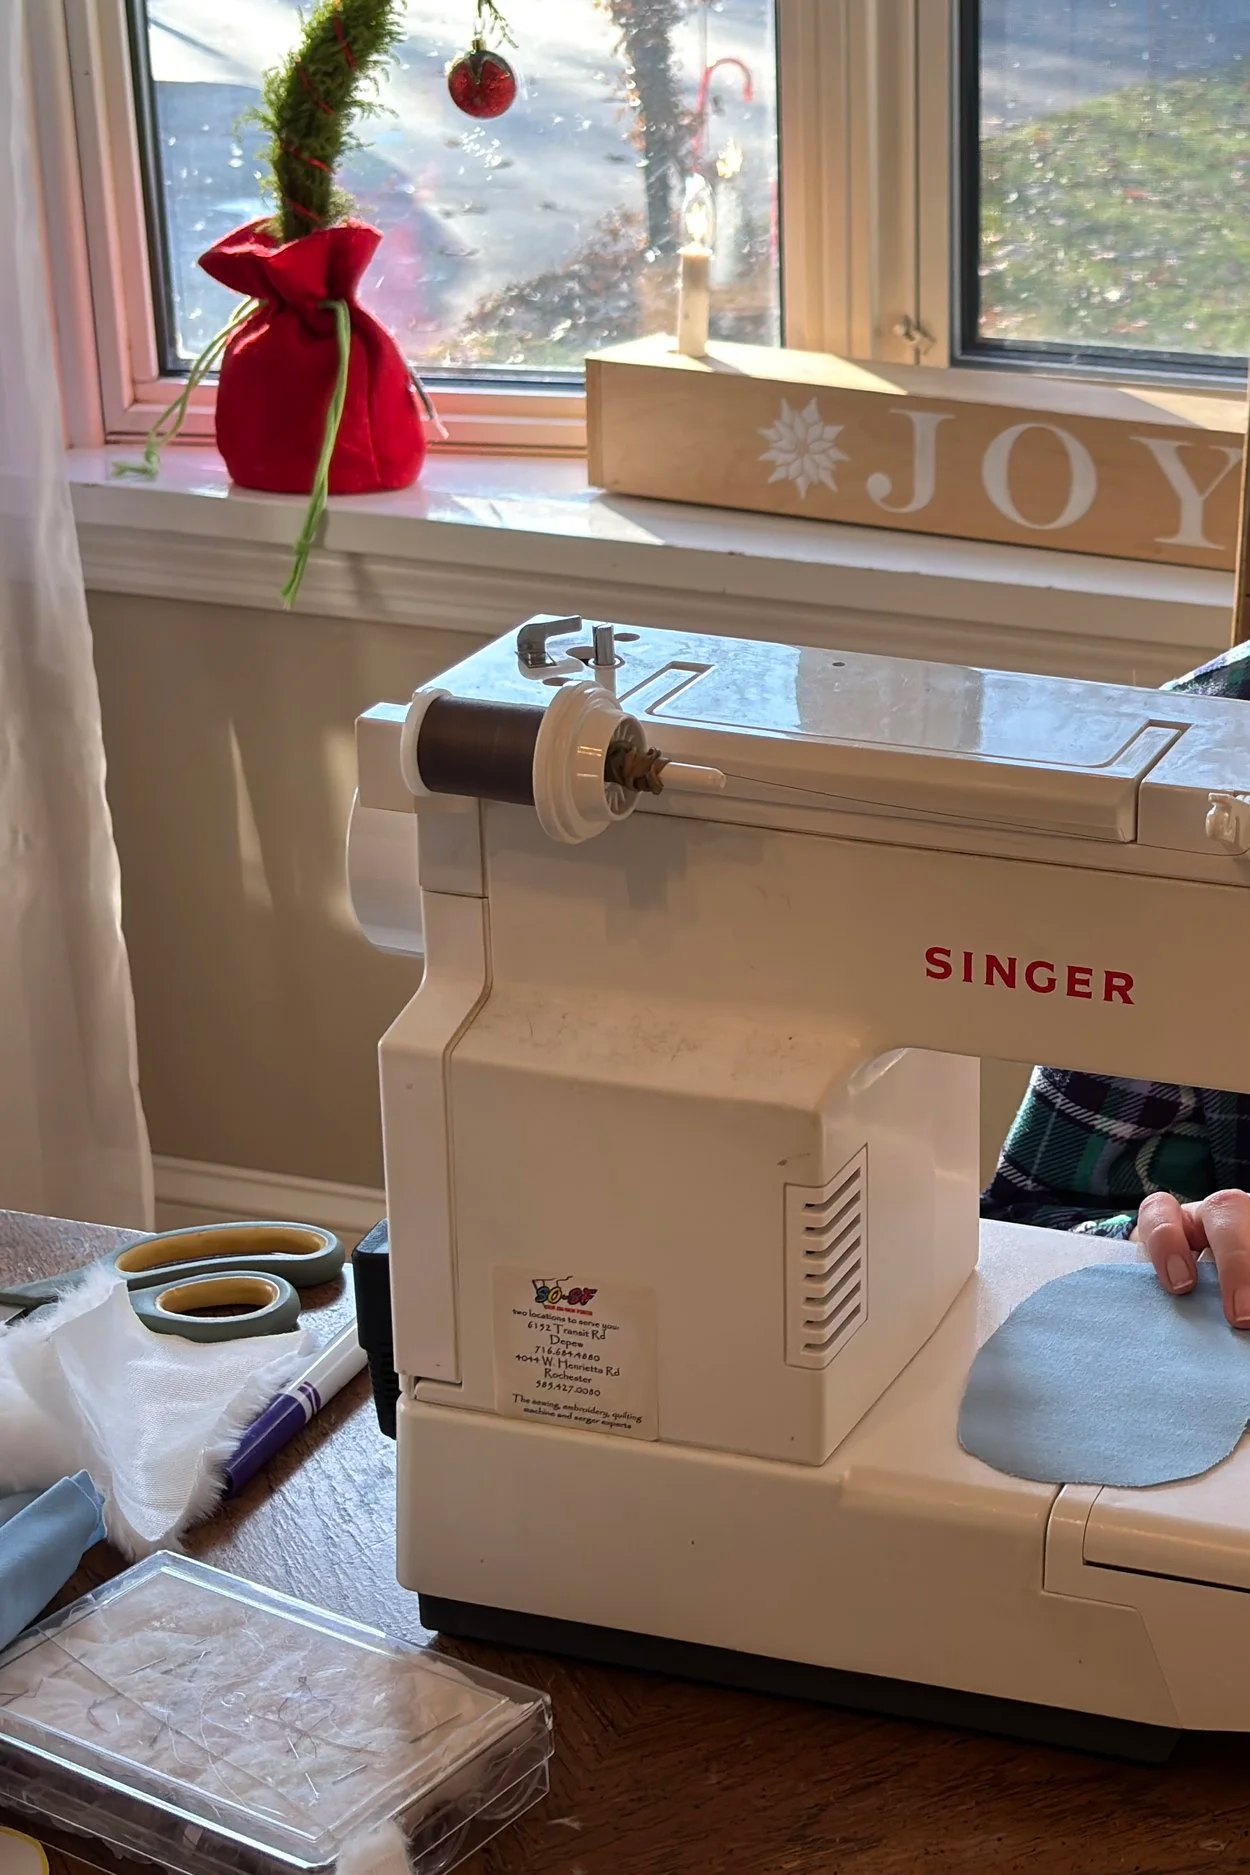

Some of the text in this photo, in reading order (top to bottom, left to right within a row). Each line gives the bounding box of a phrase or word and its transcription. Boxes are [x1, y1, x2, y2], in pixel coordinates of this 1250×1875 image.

[866, 408, 1242, 550] JOY
[925, 946, 1135, 1005] SINGER
[512, 1308, 527, 1317] two
[529, 1309, 566, 1323] locations
[567, 1316, 577, 1324] to
[578, 1320, 600, 1328] serve
[550, 1334, 584, 1349] Depew
[553, 1323, 589, 1338] Transit
[592, 1329, 606, 1340] Rd
[515, 1354, 539, 1364] 4044
[558, 1358, 603, 1375] Henrietta
[605, 1366, 620, 1377] Rd
[544, 1367, 593, 1384] Rochester
[512, 1393, 530, 1404] The
[612, 1410, 642, 1424] quilting
[523, 1407, 632, 1430] machine and serger experts
